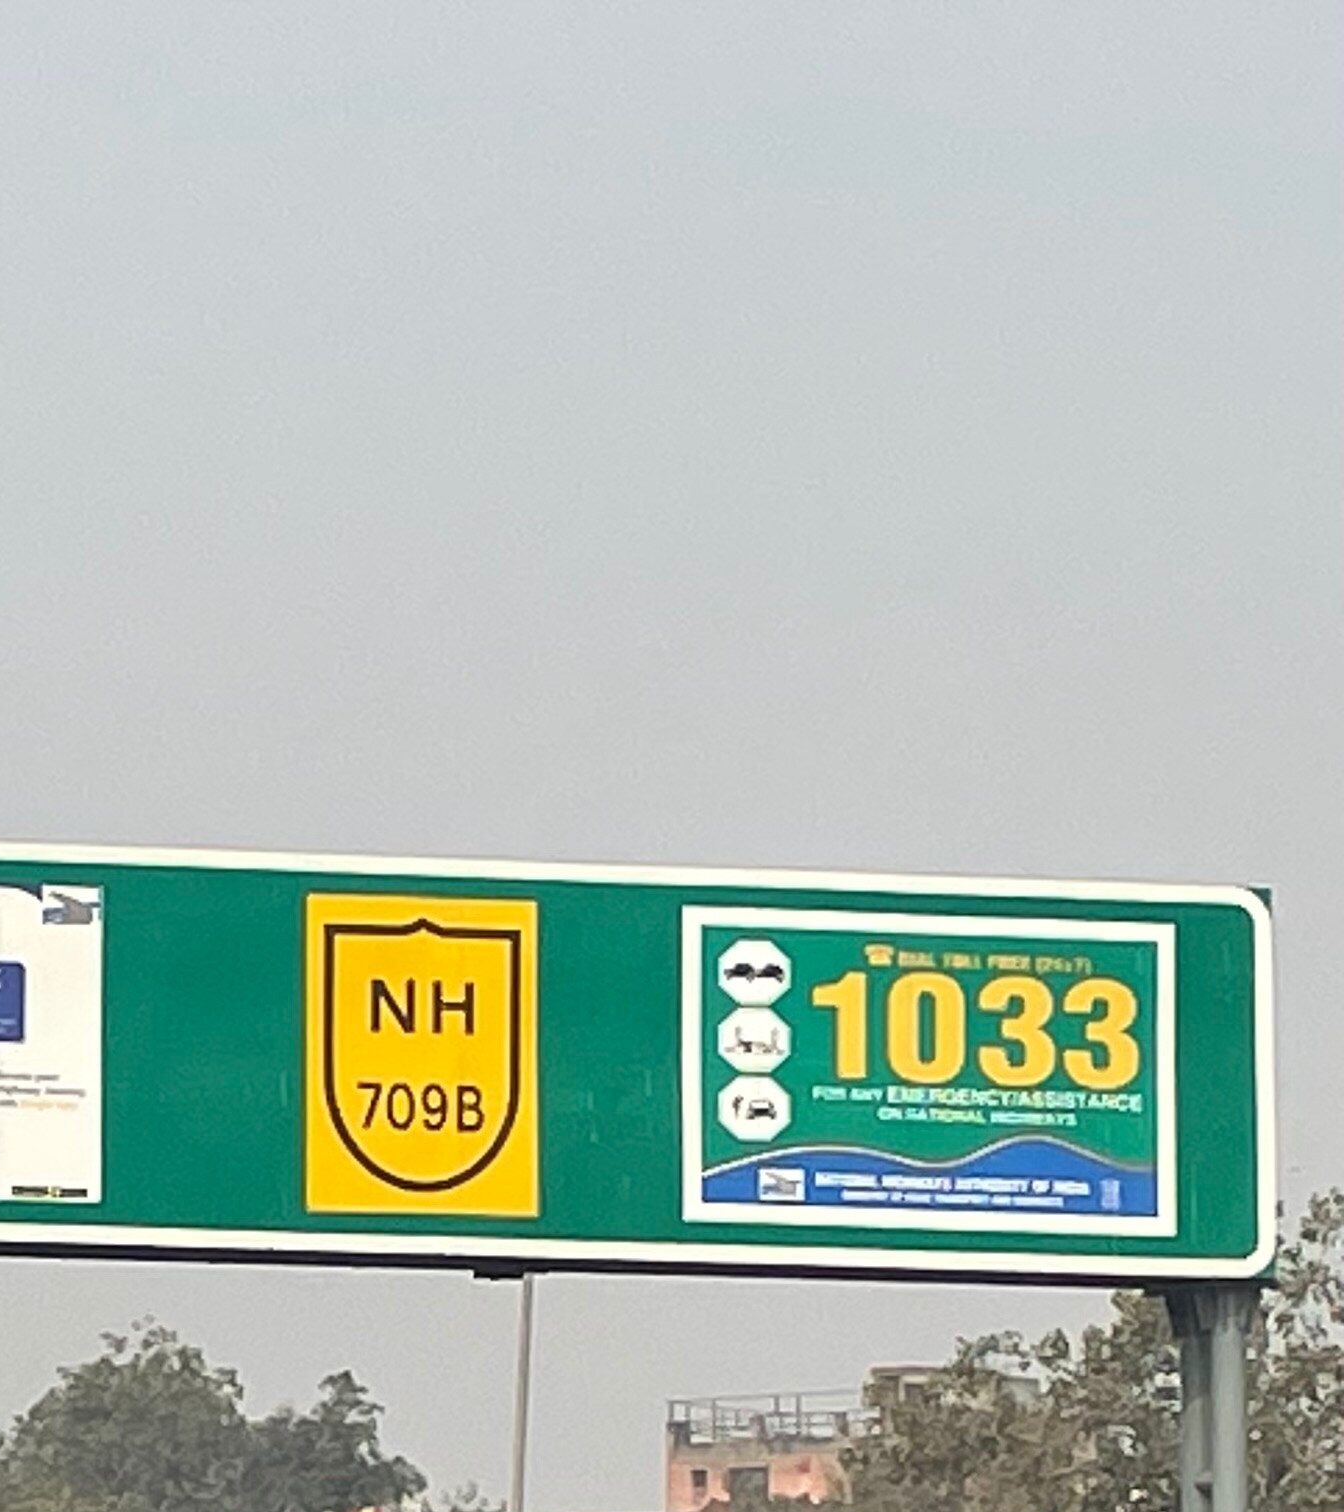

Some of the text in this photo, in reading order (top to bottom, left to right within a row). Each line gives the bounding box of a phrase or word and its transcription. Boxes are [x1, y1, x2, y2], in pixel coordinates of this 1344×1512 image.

[369, 979, 477, 1036] NH
[812, 971, 1141, 1090] 1033
[355, 1081, 486, 1134] 709B
